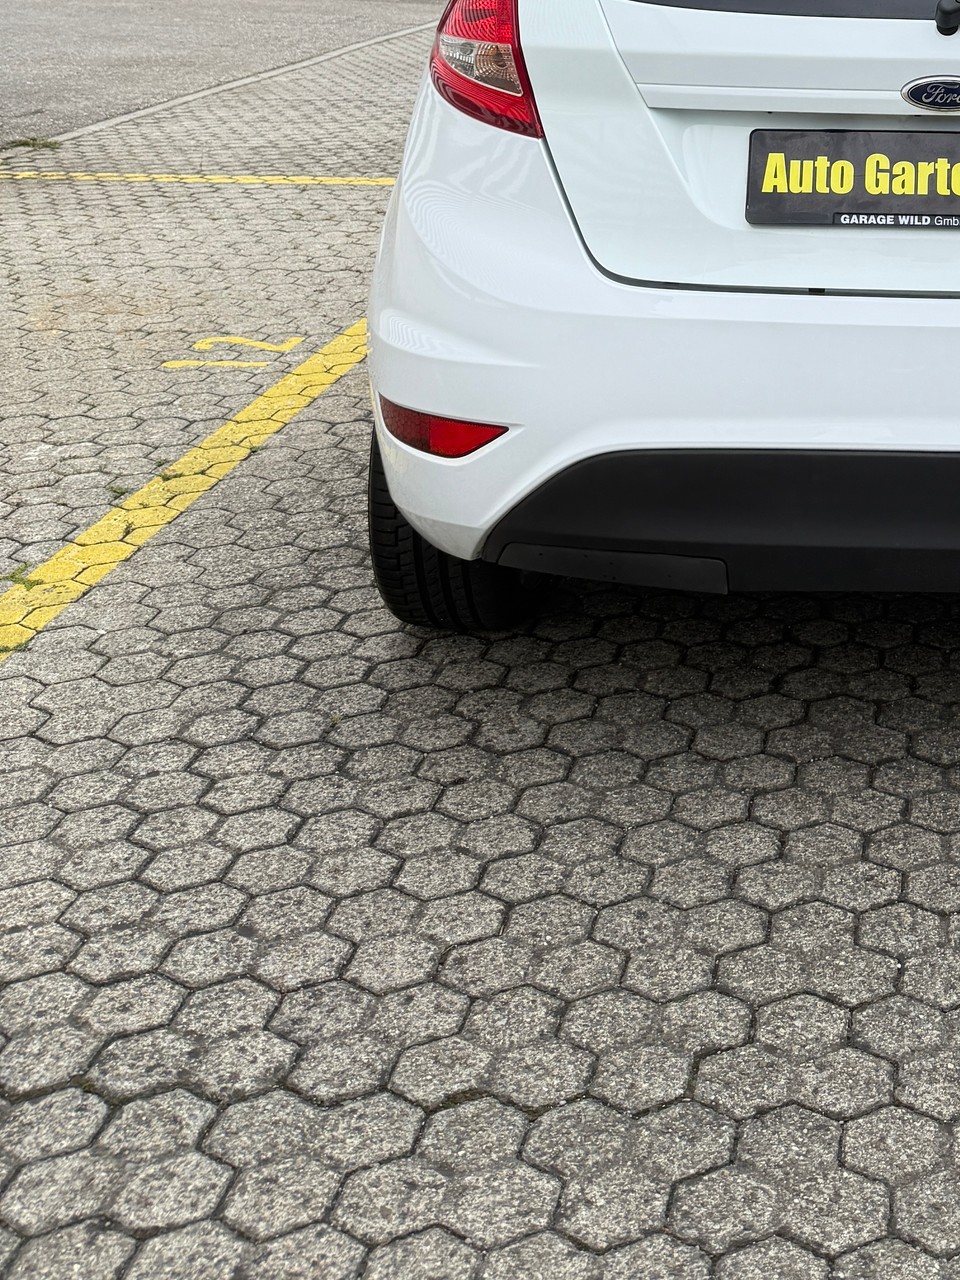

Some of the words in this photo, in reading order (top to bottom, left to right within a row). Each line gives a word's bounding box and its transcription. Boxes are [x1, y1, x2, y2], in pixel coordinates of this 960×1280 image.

[761, 152, 854, 194] Auto
[840, 214, 895, 225] GARAGE
[898, 215, 931, 226] WILD
[161, 336, 305, 369] 12
